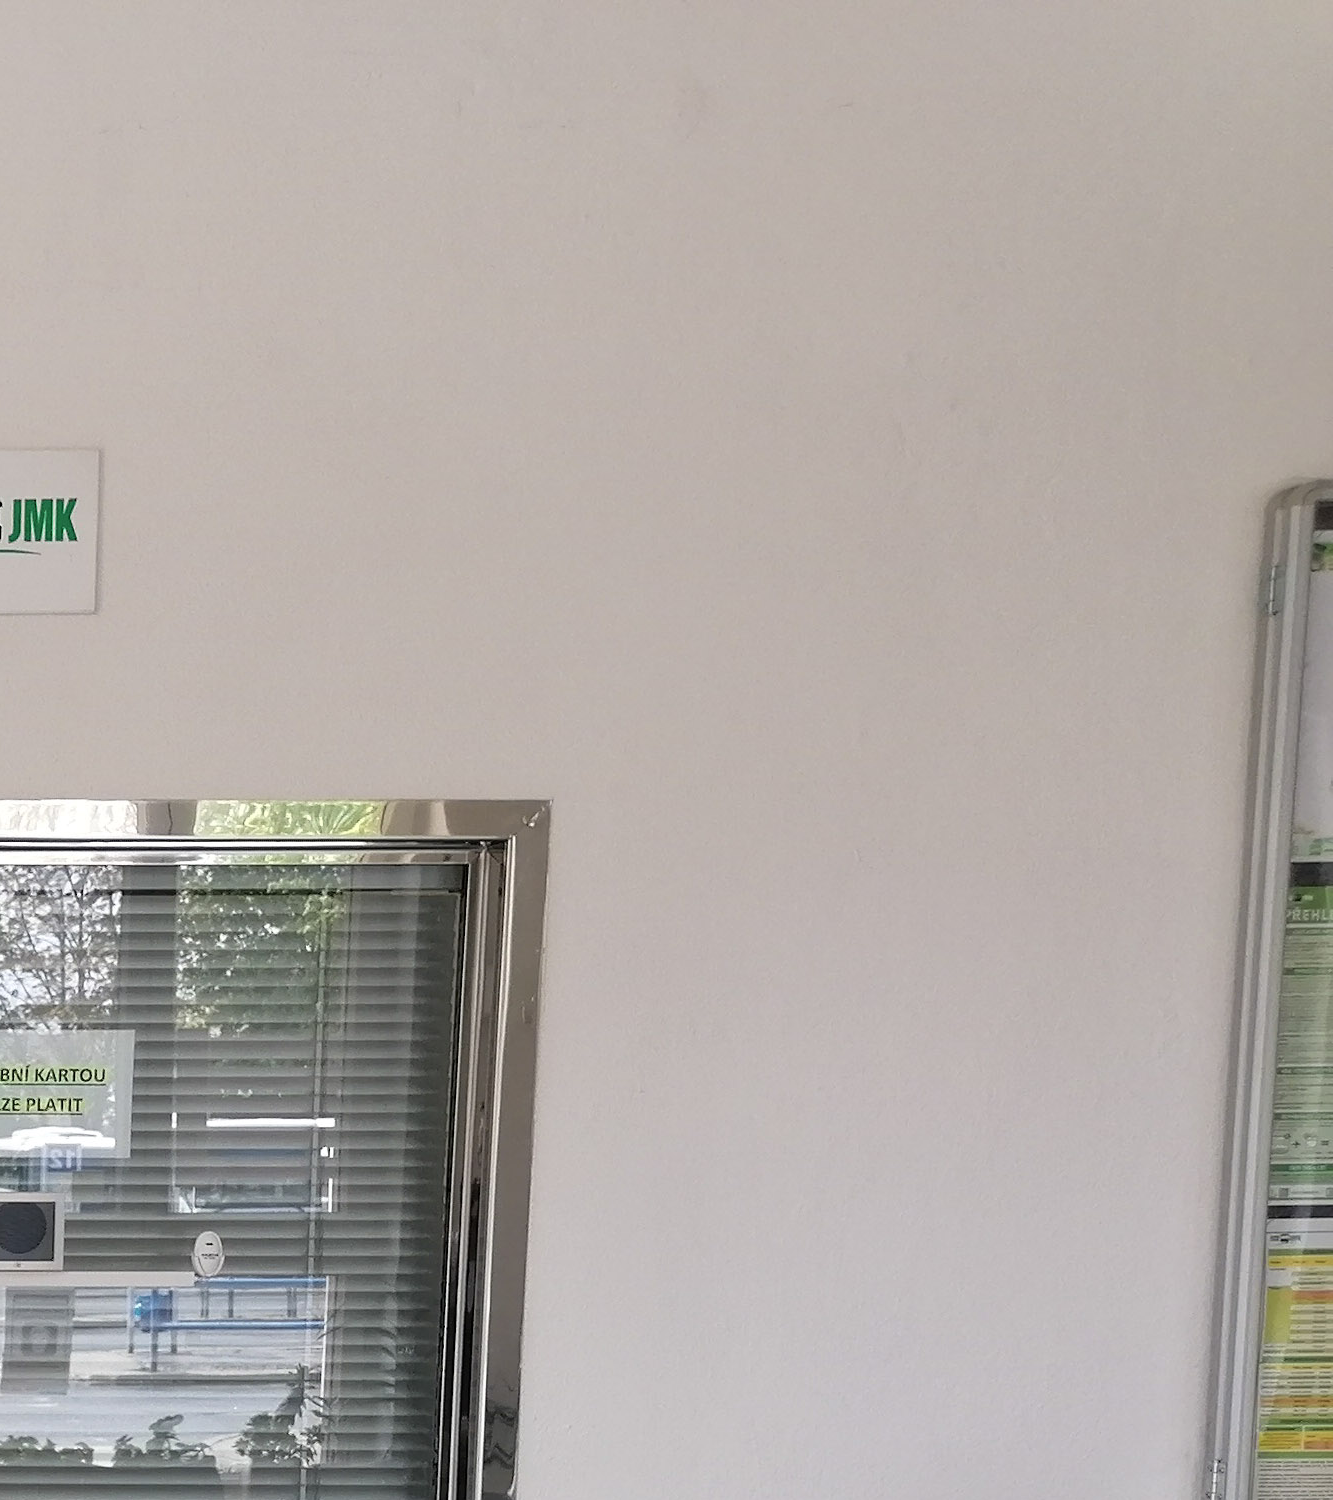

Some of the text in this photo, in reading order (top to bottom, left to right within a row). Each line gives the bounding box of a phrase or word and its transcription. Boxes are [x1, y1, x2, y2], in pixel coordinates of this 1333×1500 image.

[8, 498, 78, 543] JMK
[35, 1068, 106, 1082] KARTOU
[26, 1098, 83, 1112] PLATIT
